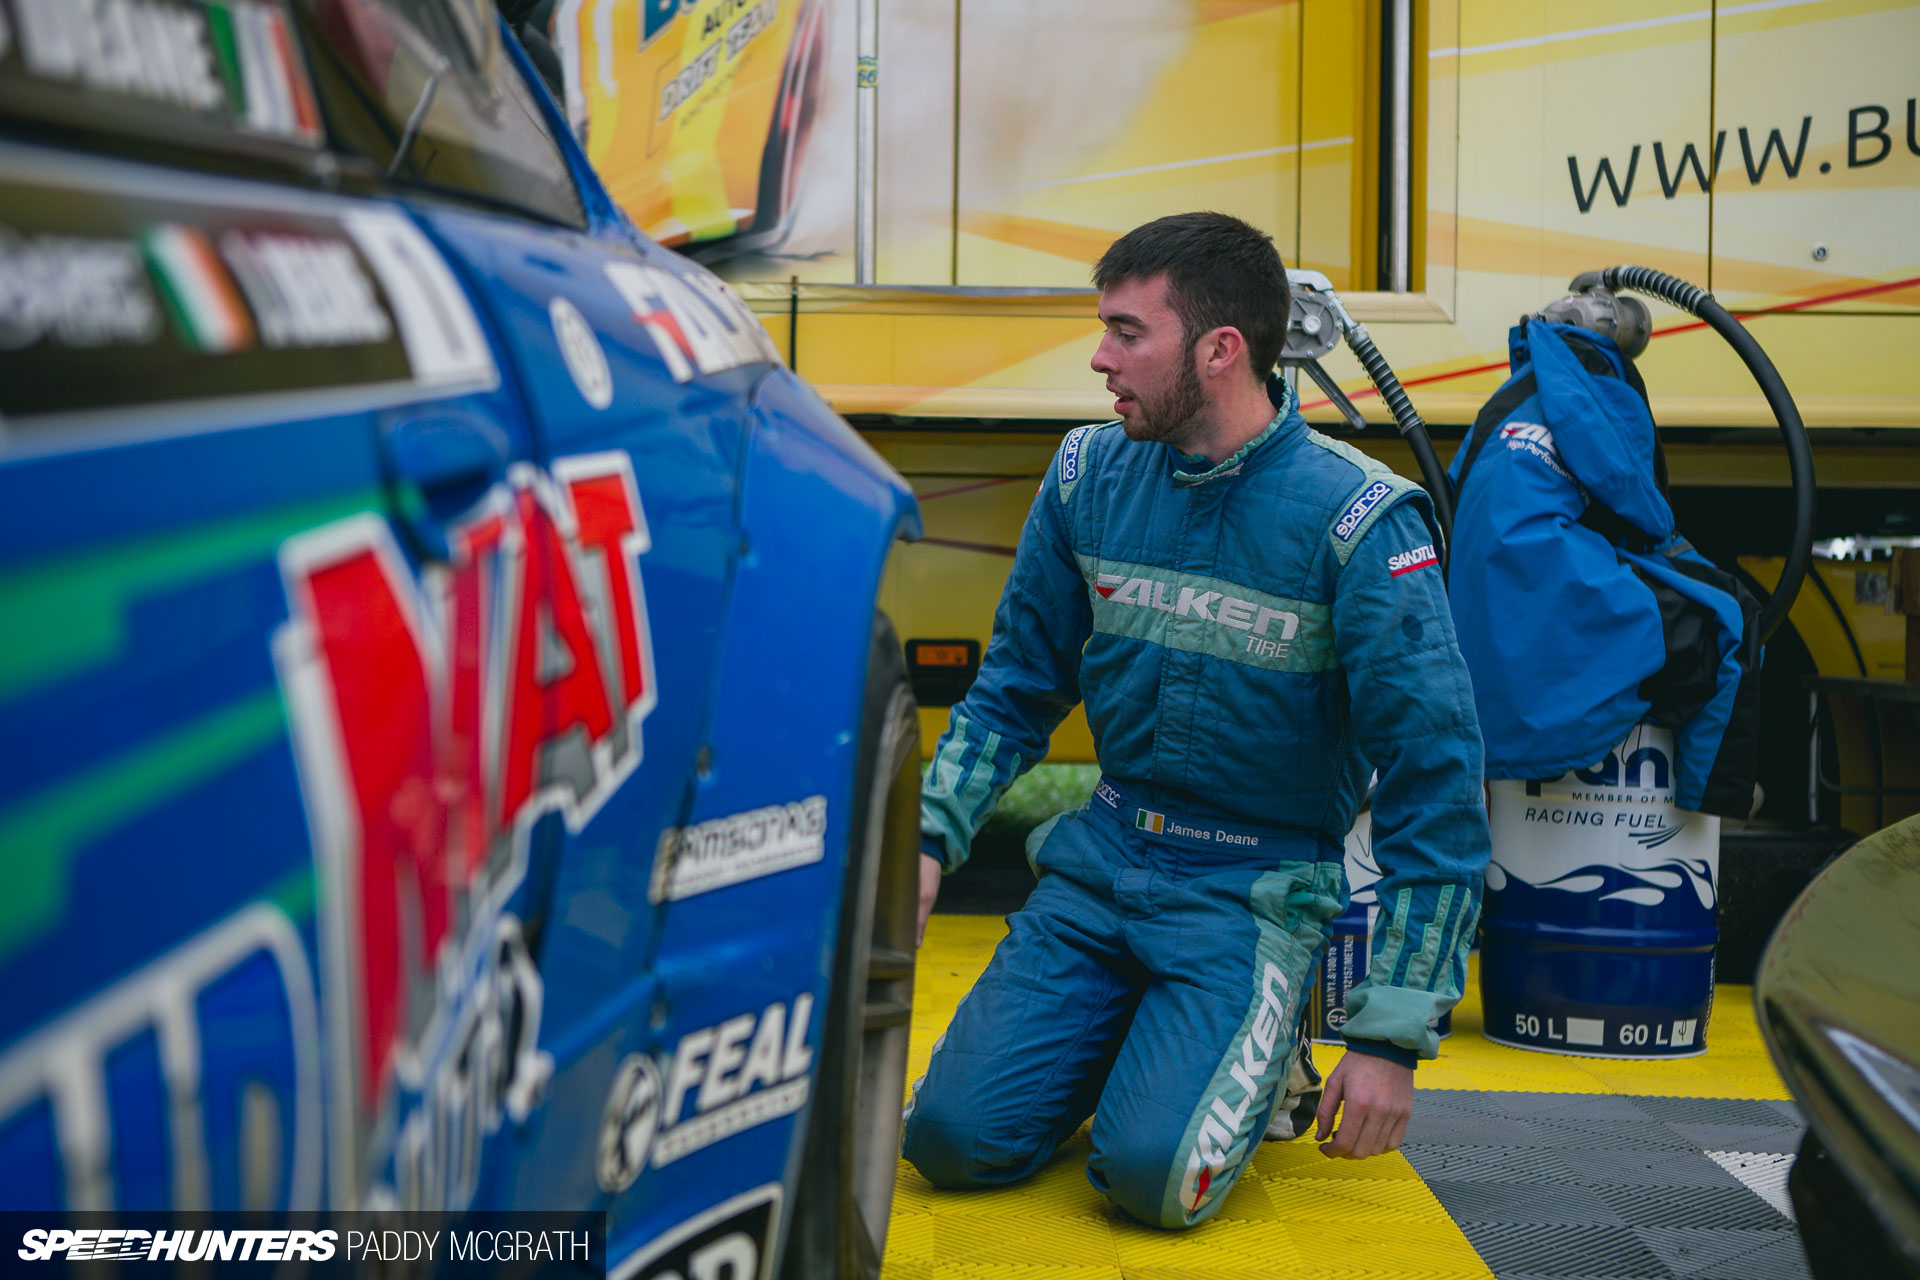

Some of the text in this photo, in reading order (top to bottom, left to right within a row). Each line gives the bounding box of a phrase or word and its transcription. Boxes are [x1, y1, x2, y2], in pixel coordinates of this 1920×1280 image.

[1063, 429, 1087, 480] sparco
[1336, 483, 1389, 539] sparco
[1246, 635, 1290, 659] TIRE
[1572, 791, 1633, 804] MEMBER
[1640, 795, 1657, 804] OF
[1525, 807, 1667, 828] RACING FUEL
[1167, 821, 1259, 847] James Deane
[1515, 1013, 1563, 1040] 50 L
[1619, 1024, 1669, 1046] 60 L
[661, 991, 815, 1128] FEAL
